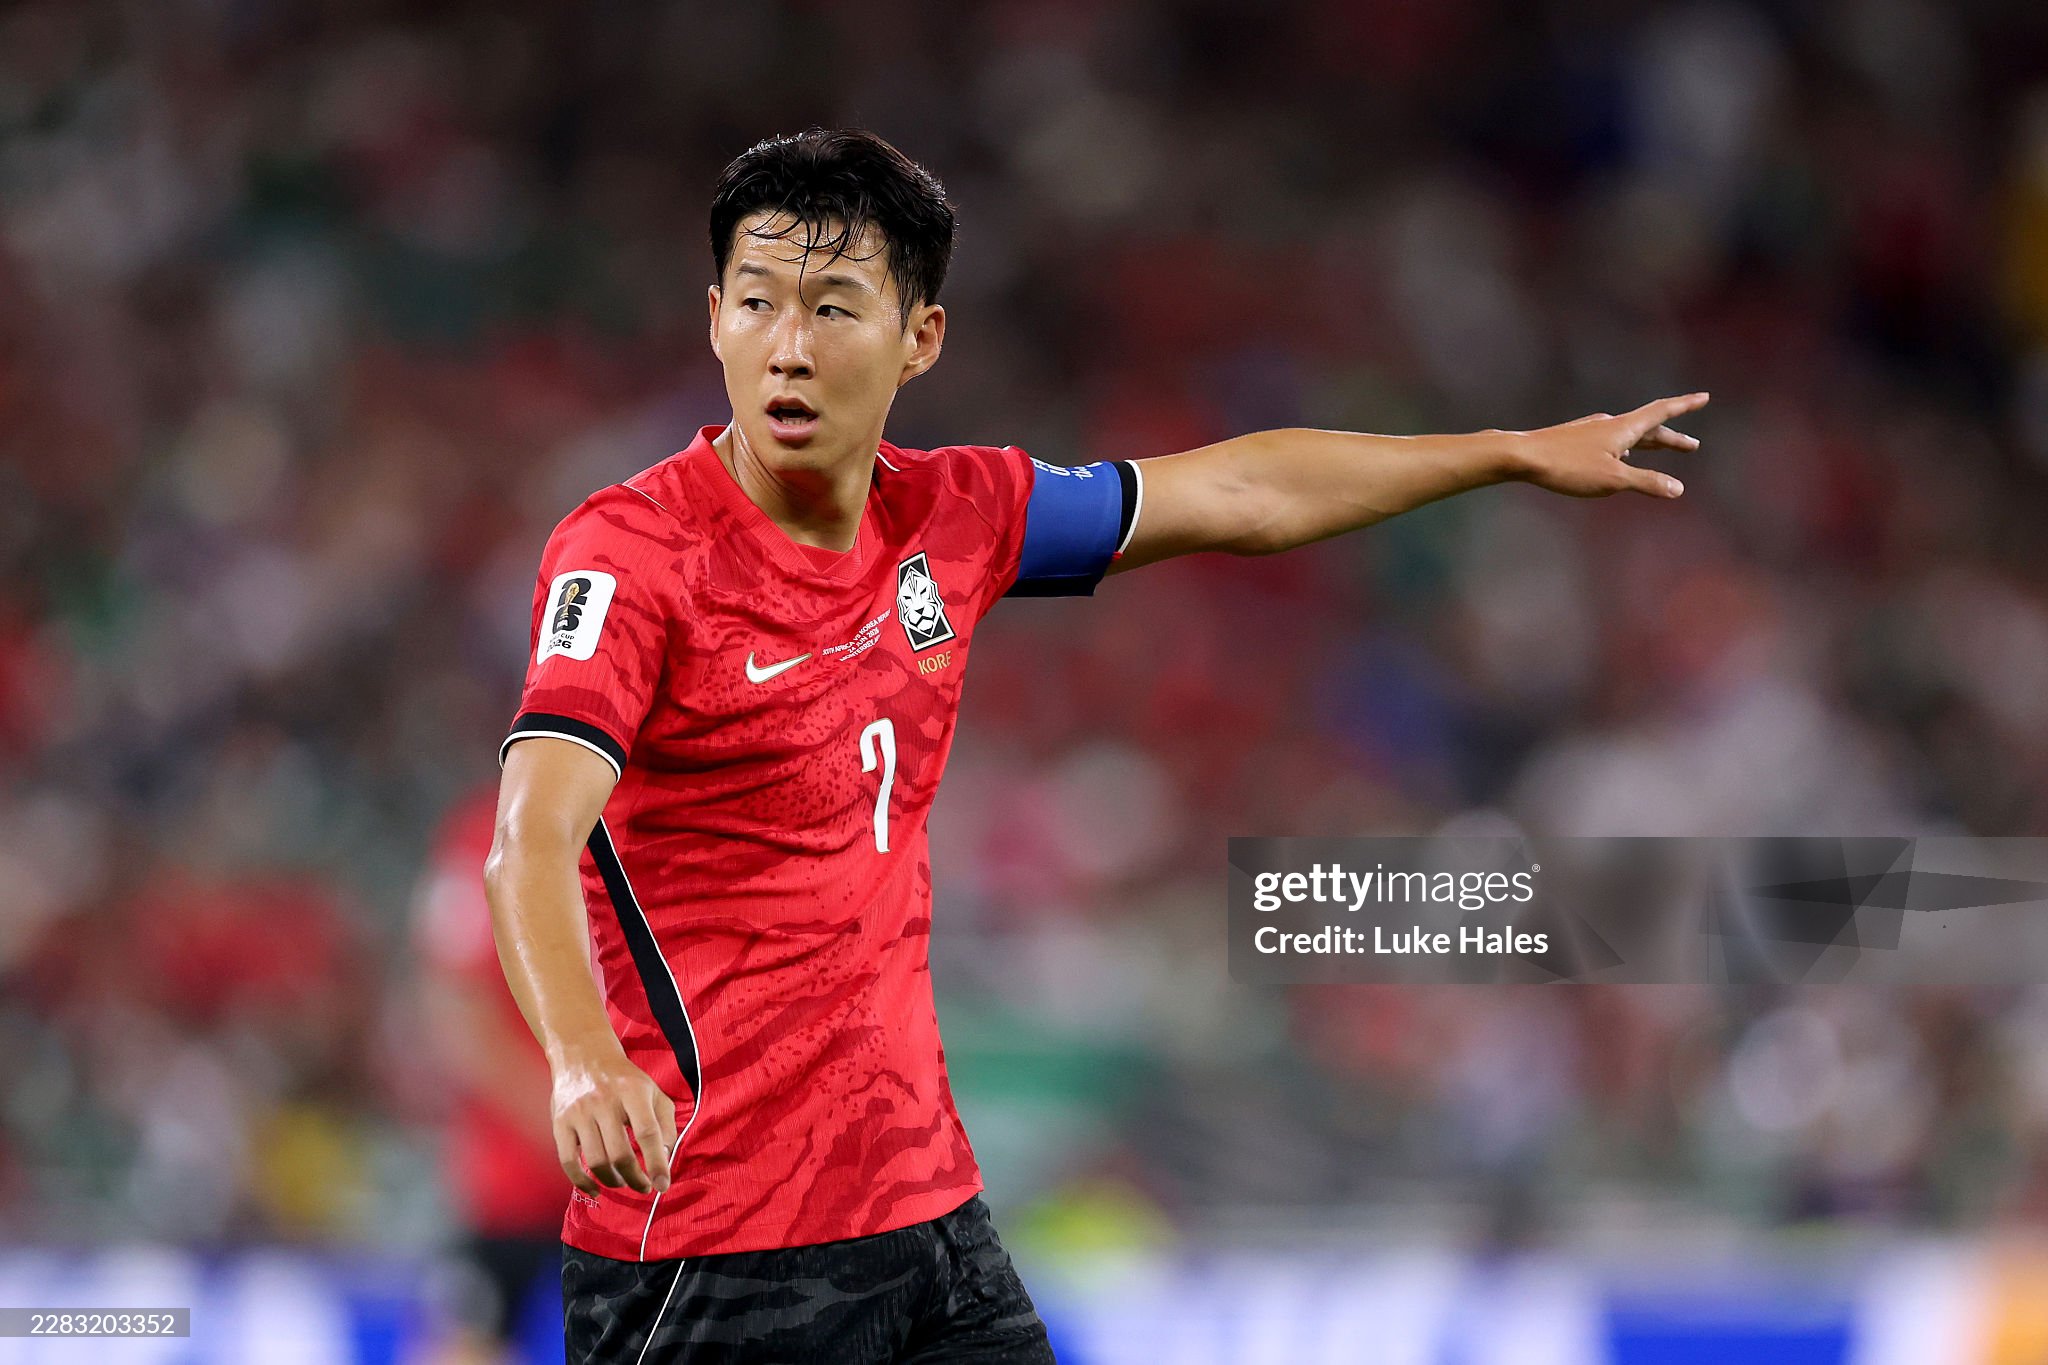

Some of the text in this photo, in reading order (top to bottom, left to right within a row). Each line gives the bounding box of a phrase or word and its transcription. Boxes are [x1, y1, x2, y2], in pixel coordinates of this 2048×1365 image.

[859, 619, 879, 635] KOREA
[561, 632, 575, 640] CUP
[856, 636, 868, 647] JUN
[859, 717, 897, 854] 7
